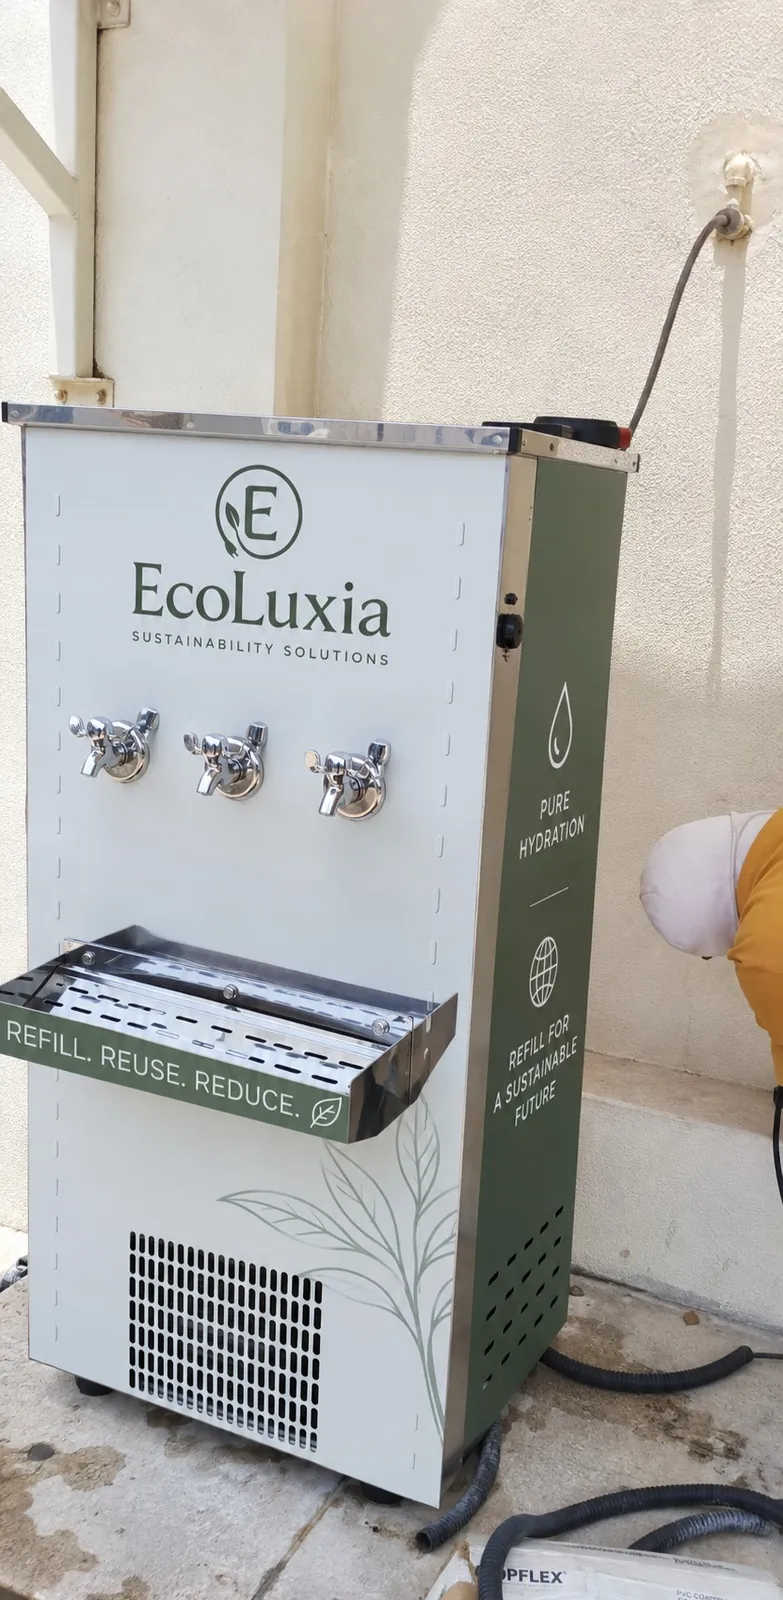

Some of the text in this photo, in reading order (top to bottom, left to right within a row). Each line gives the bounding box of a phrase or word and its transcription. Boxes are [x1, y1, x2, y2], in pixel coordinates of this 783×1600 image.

[244, 485, 278, 541] E
[132, 561, 391, 638] EcoLuxia
[132, 630, 389, 666] SUSTAINABILITY SOLUTIONS
[539, 790, 571, 820] PURE
[518, 814, 585, 860] HYDRATION
[6, 1019, 300, 1118] REFILL. REUSE. REDUCE.
[508, 1013, 570, 1072] REFILL FOR
[493, 1035, 578, 1114] A SUSTAINABLE
[514, 1080, 557, 1127] FUTURE
